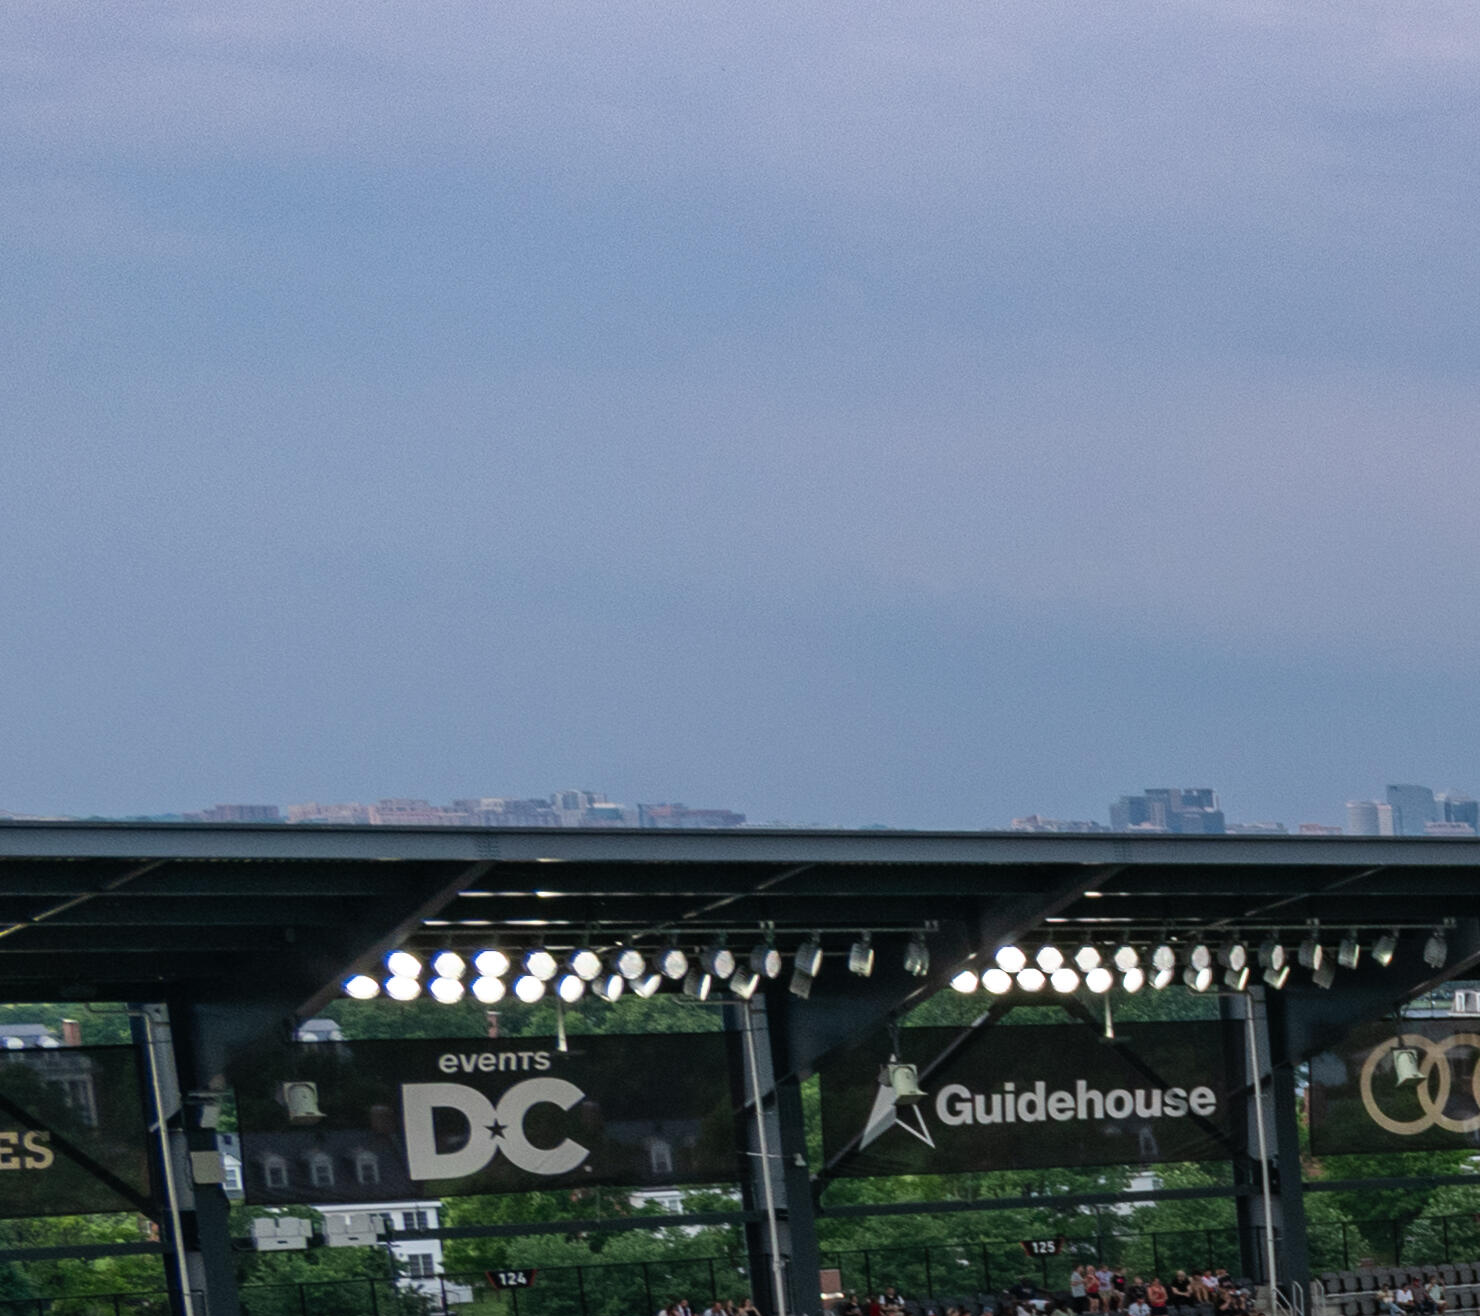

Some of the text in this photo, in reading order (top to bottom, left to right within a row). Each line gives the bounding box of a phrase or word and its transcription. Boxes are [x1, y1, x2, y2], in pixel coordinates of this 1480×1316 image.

[439, 1049, 552, 1073] events
[936, 1079, 1217, 1127] Guidehouse
[403, 1077, 592, 1181] DC
[1032, 1241, 1056, 1255] 125
[499, 1272, 528, 1286] 124
